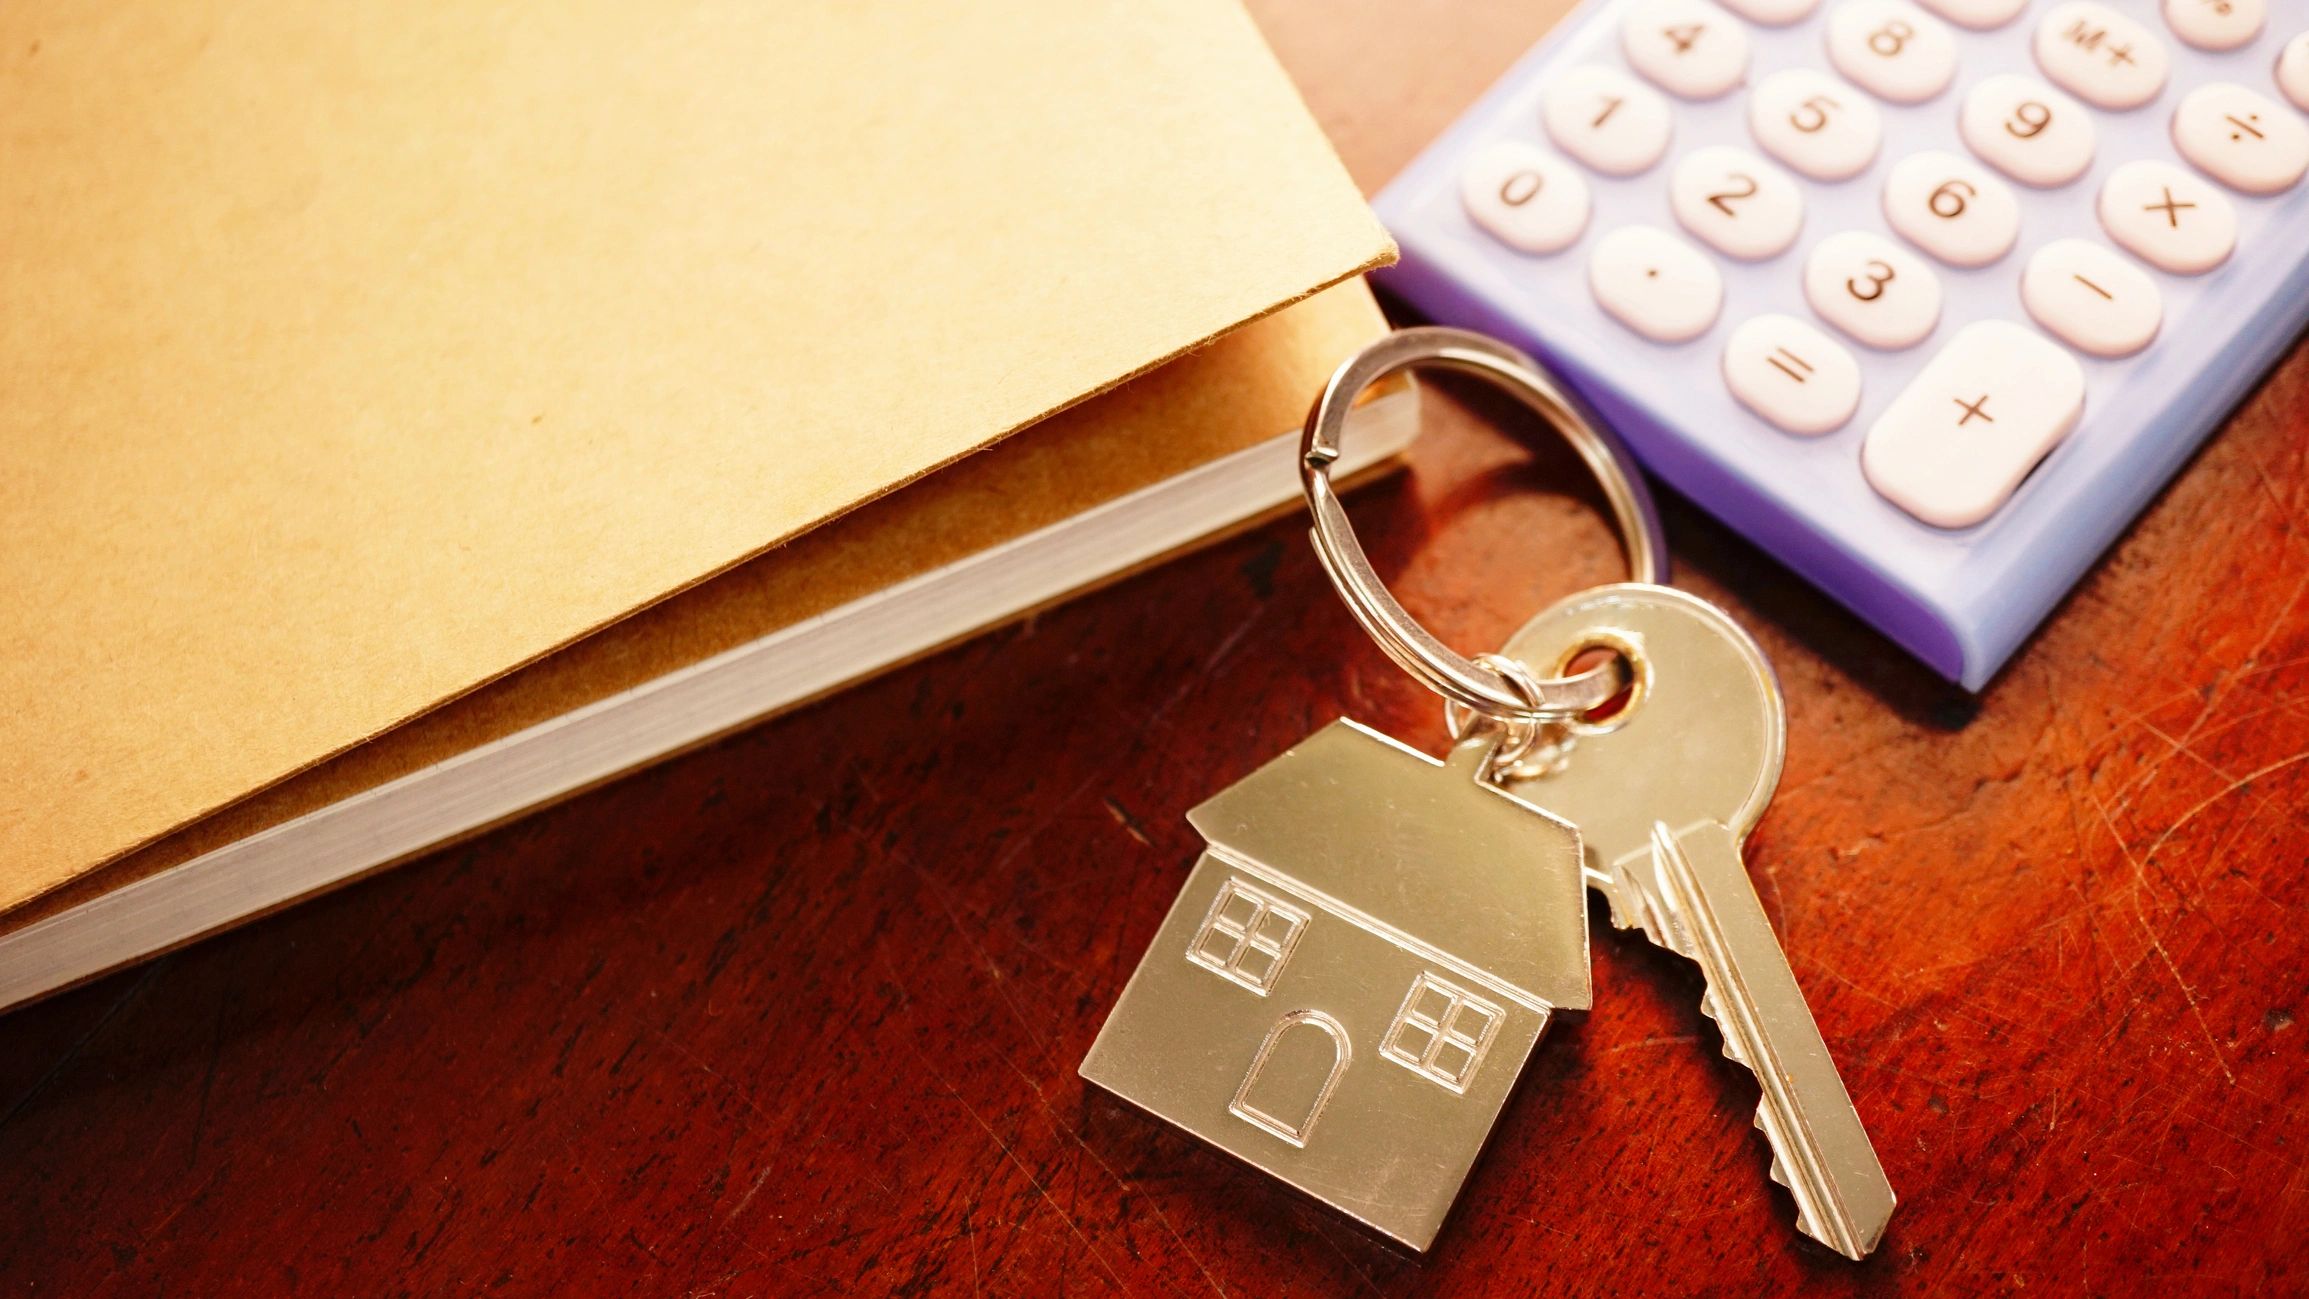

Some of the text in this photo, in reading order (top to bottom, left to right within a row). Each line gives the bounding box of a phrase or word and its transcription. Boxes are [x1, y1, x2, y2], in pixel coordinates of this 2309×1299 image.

[1662, 24, 1705, 56] 4
[1866, 21, 1915, 59] 8
[1590, 98, 1623, 129] 1
[1789, 95, 1840, 135] 5
[2005, 101, 2052, 140] 9
[1498, 171, 1545, 209] 0
[1706, 172, 1758, 218] 2
[1928, 180, 1977, 220] 6
[1846, 260, 1896, 303] 3
